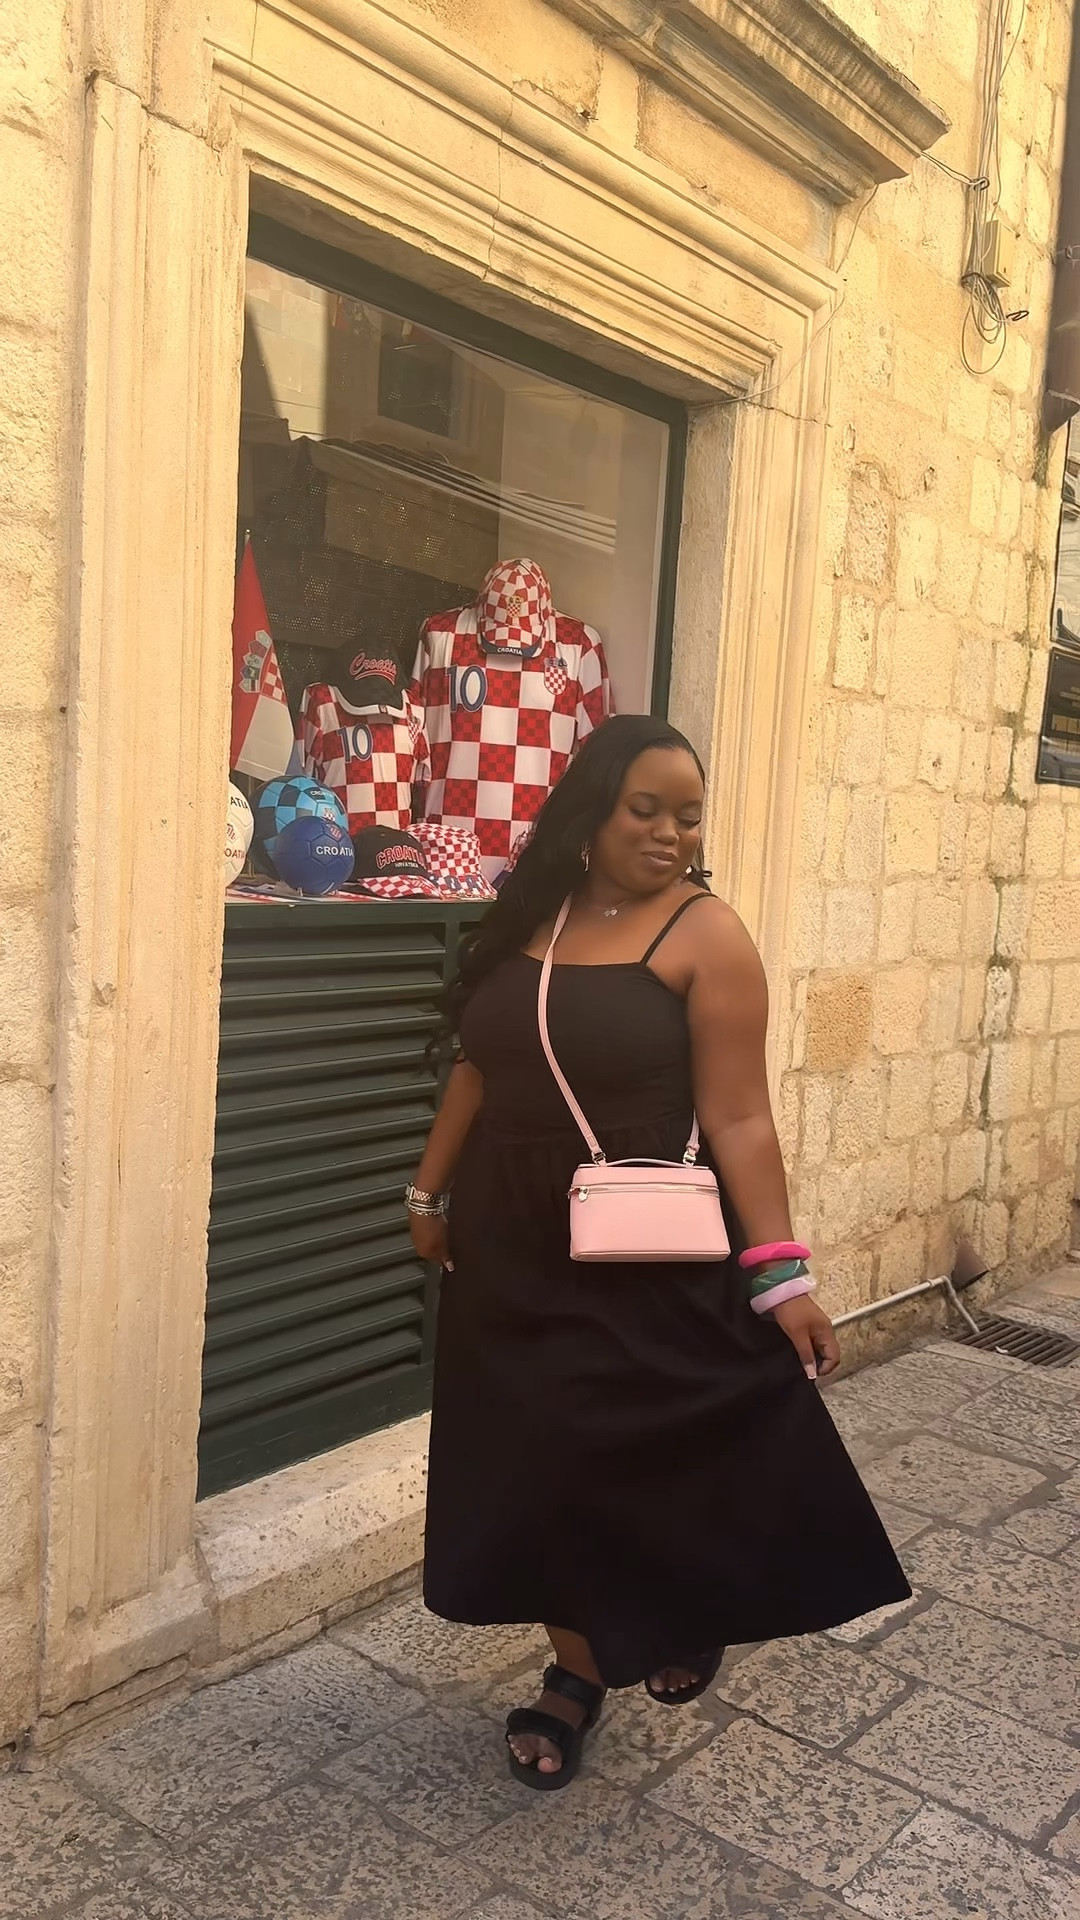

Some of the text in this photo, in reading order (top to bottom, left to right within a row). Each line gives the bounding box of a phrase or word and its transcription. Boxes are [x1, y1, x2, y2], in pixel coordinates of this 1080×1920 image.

[497, 647, 523, 656] CROATIA
[445, 664, 488, 713] 10
[336, 723, 373, 763] 10
[230, 796, 249, 810] ATIA
[224, 848, 246, 859] OATI
[316, 845, 354, 857] CROATIA
